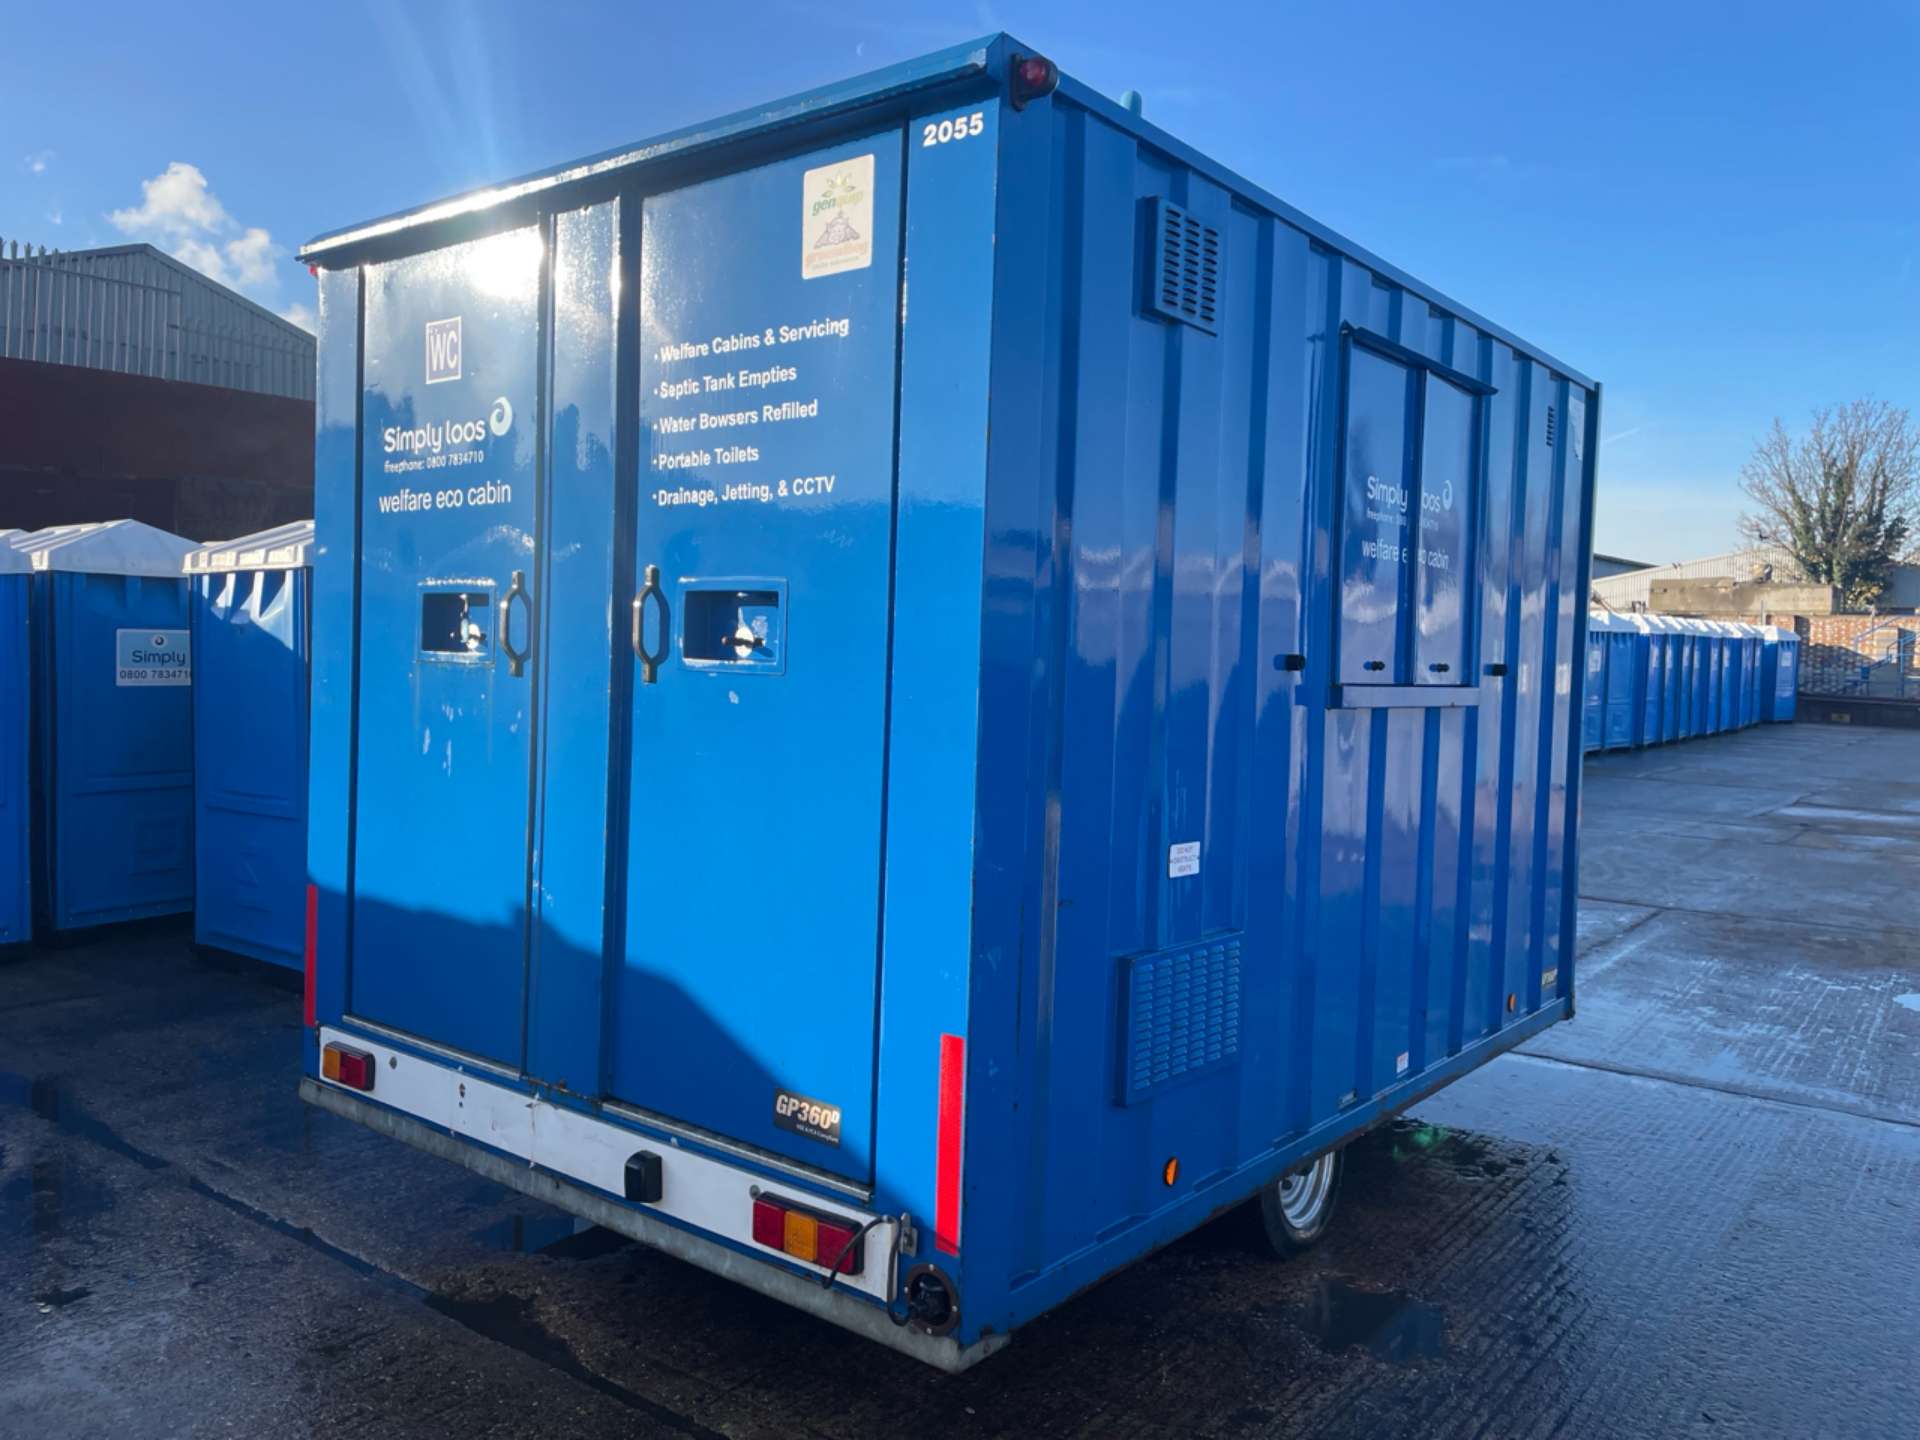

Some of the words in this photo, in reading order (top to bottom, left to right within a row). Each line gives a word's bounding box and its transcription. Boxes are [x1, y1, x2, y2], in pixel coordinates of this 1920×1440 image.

[922, 112, 984, 147] 2055
[429, 330, 457, 372] WC
[660, 343, 709, 363] Welfare
[712, 333, 760, 354] Cabins
[764, 328, 775, 346] &
[779, 318, 849, 343] Servicing
[660, 378, 700, 400] Septic
[703, 372, 735, 391] Tank
[739, 365, 797, 388] Empties
[659, 416, 696, 434] Water
[700, 409, 758, 430] Bowsers
[763, 399, 818, 422] Refilled
[384, 423, 442, 455] Simply
[446, 420, 486, 444] loos
[658, 450, 711, 470] Portable
[714, 445, 759, 464] Toilets
[379, 488, 432, 513] welfare
[436, 488, 463, 509] eco
[467, 480, 511, 505] cabin
[658, 487, 718, 507] Drainage,
[721, 482, 774, 503] Jetting,
[777, 479, 788, 496] &
[792, 475, 836, 496] CCTV
[1367, 475, 1408, 513] Simply
[1422, 491, 1441, 513] oos
[1361, 538, 1399, 562] welfare
[1428, 548, 1449, 570] cabin
[120, 670, 148, 679] 0800
[151, 670, 191, 679] 783471
[131, 649, 186, 667] Simply
